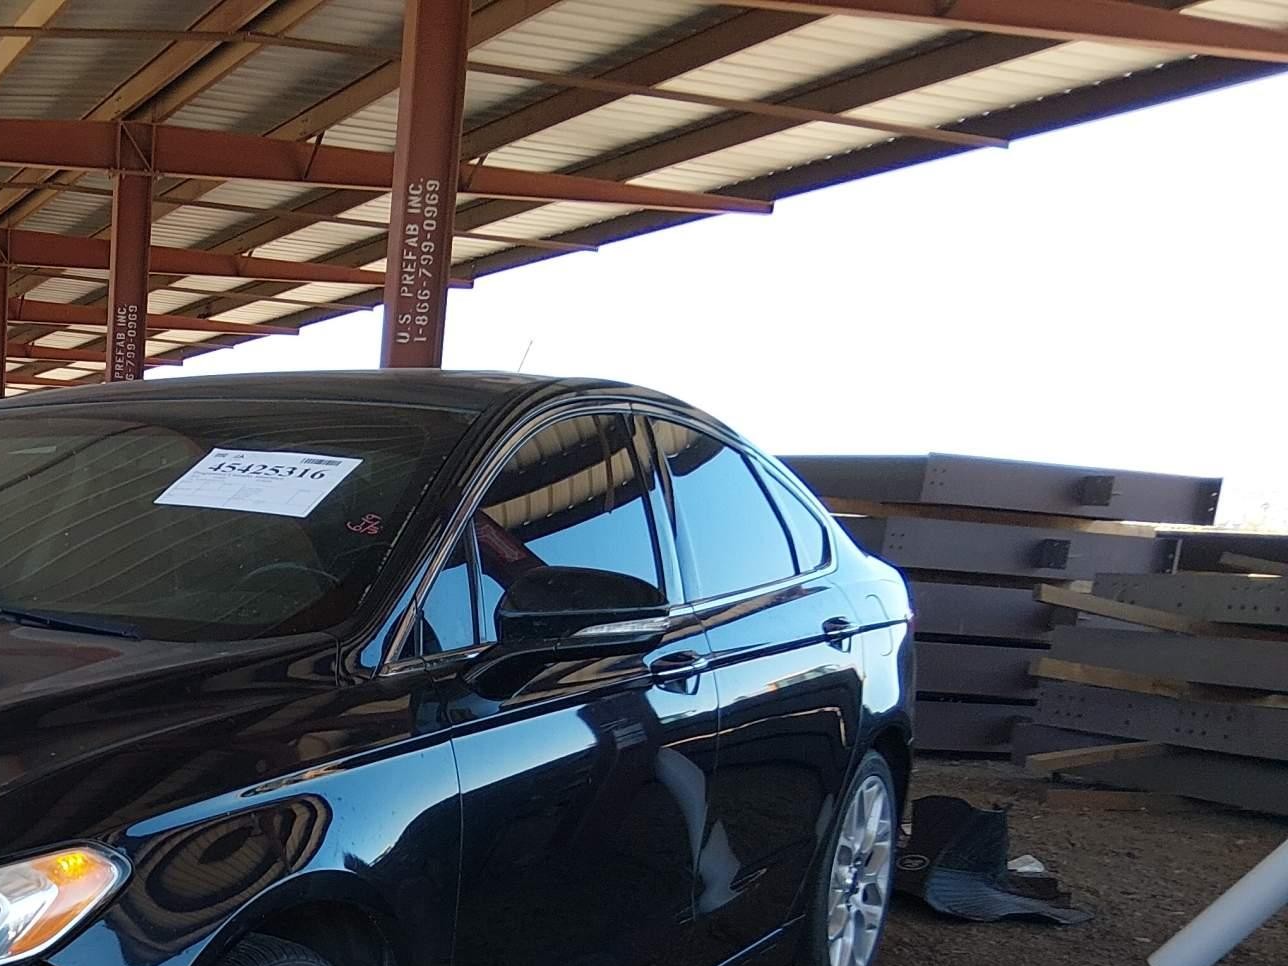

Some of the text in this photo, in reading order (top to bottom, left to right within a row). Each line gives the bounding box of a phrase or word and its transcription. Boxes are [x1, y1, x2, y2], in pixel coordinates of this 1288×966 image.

[408, 178, 424, 215] INC.
[400, 222, 420, 298] PREFAB
[413, 179, 440, 343] 1-866-799-0969
[114, 332, 127, 380] PREFAB
[208, 461, 330, 481] 45425316
